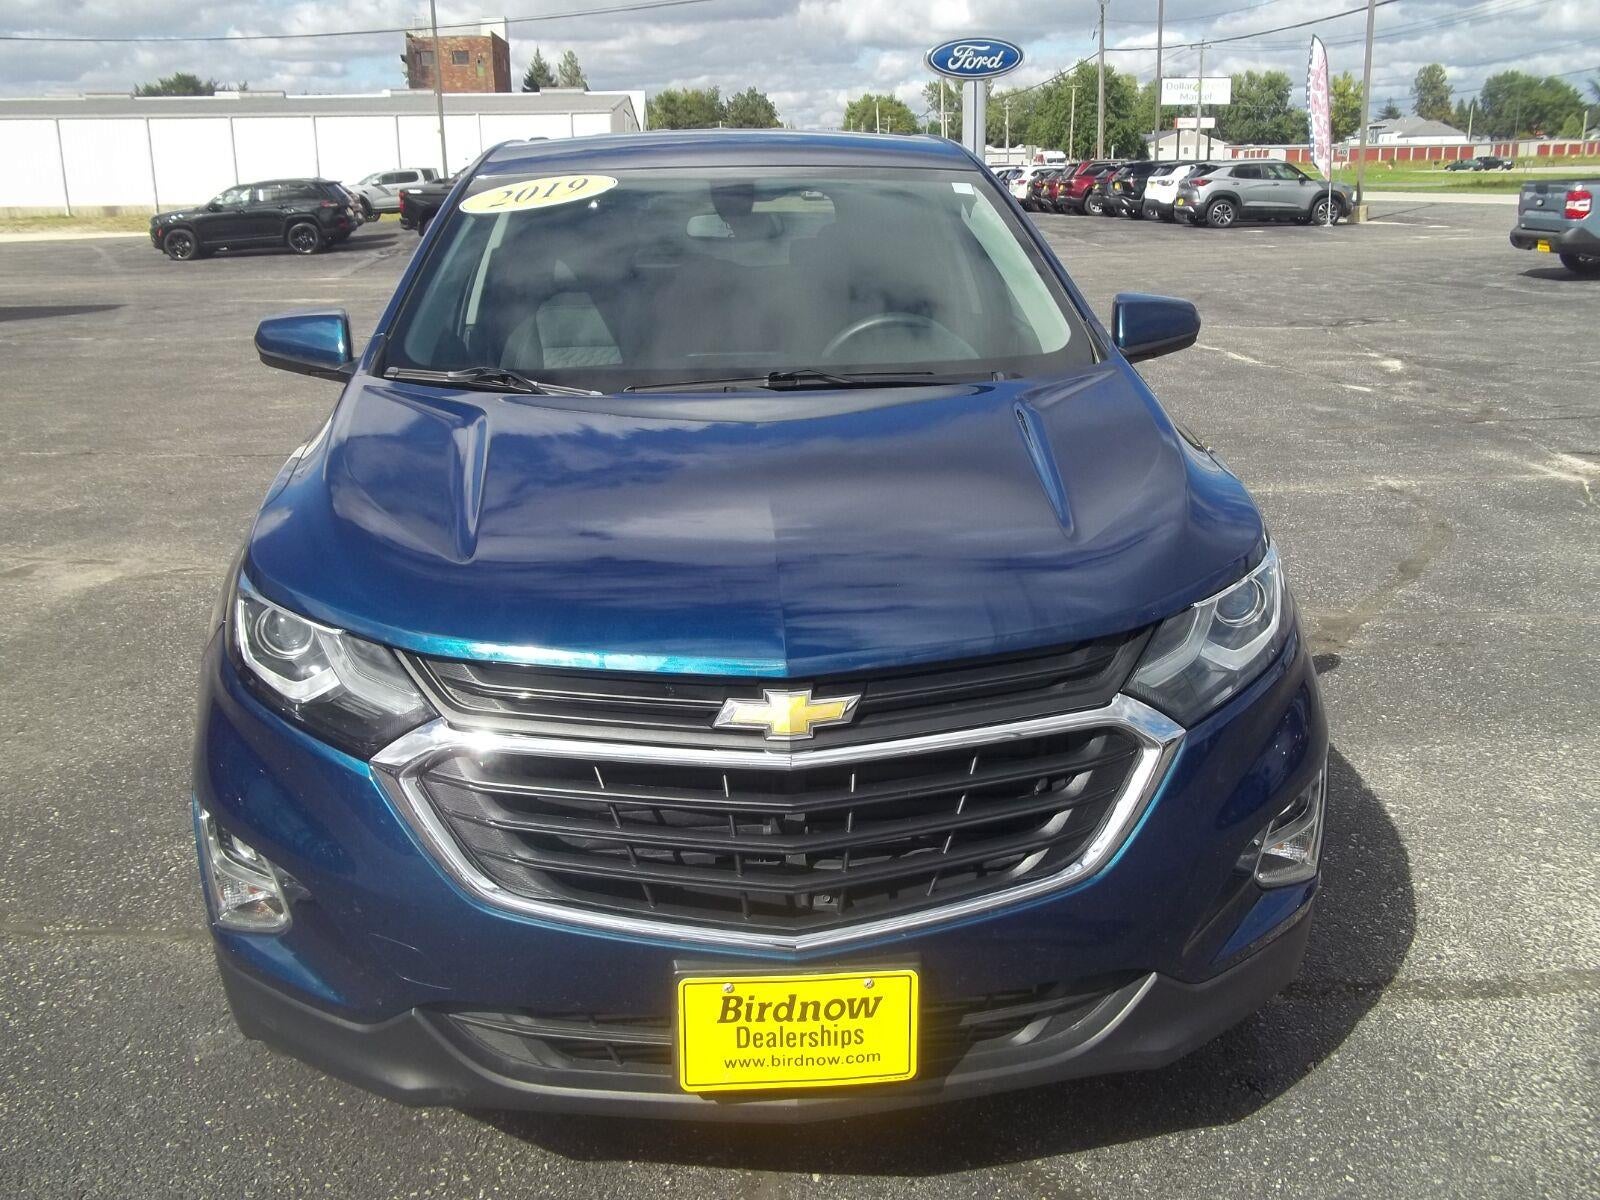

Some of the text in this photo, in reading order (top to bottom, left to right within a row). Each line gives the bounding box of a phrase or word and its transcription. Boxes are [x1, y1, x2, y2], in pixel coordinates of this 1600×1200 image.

[947, 45, 1004, 70] Ford
[1166, 82, 1193, 91] Dollar
[488, 178, 589, 208] 2019
[716, 993, 883, 1024] Birdnow
[736, 1024, 865, 1049] Dealerships
[724, 1051, 881, 1069] www.birdnow.com
